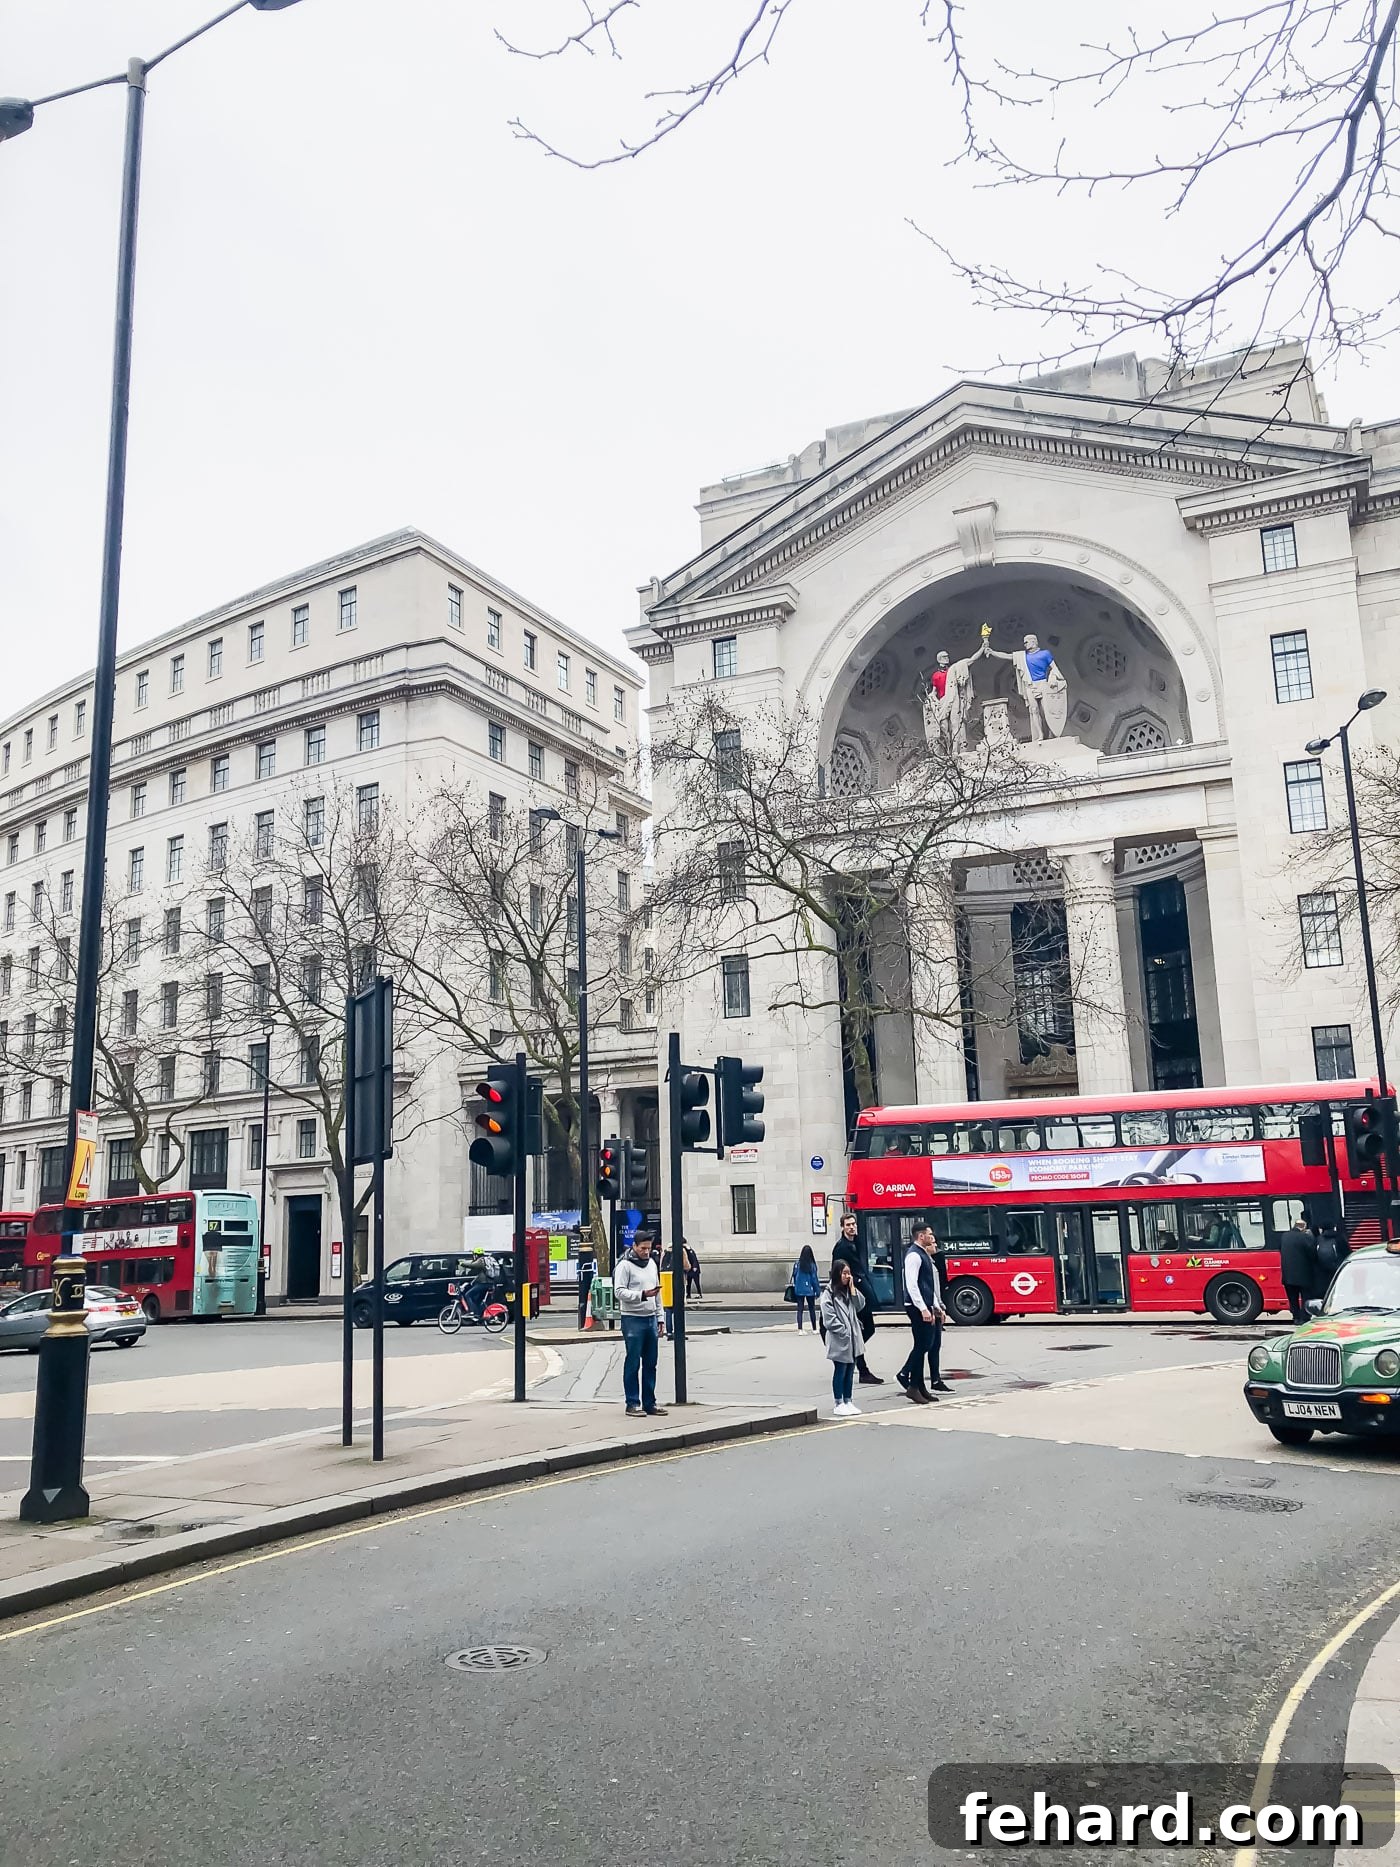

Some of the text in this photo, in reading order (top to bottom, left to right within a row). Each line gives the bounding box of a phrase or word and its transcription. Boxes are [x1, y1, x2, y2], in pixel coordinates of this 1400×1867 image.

[1053, 1157, 1091, 1165] BOOKING
[1029, 1165, 1068, 1173] ECONOMY
[885, 1183, 916, 1193] ARRIVA
[944, 1242, 957, 1251] 341
[1287, 1404, 1336, 1416] LJ04 NEN
